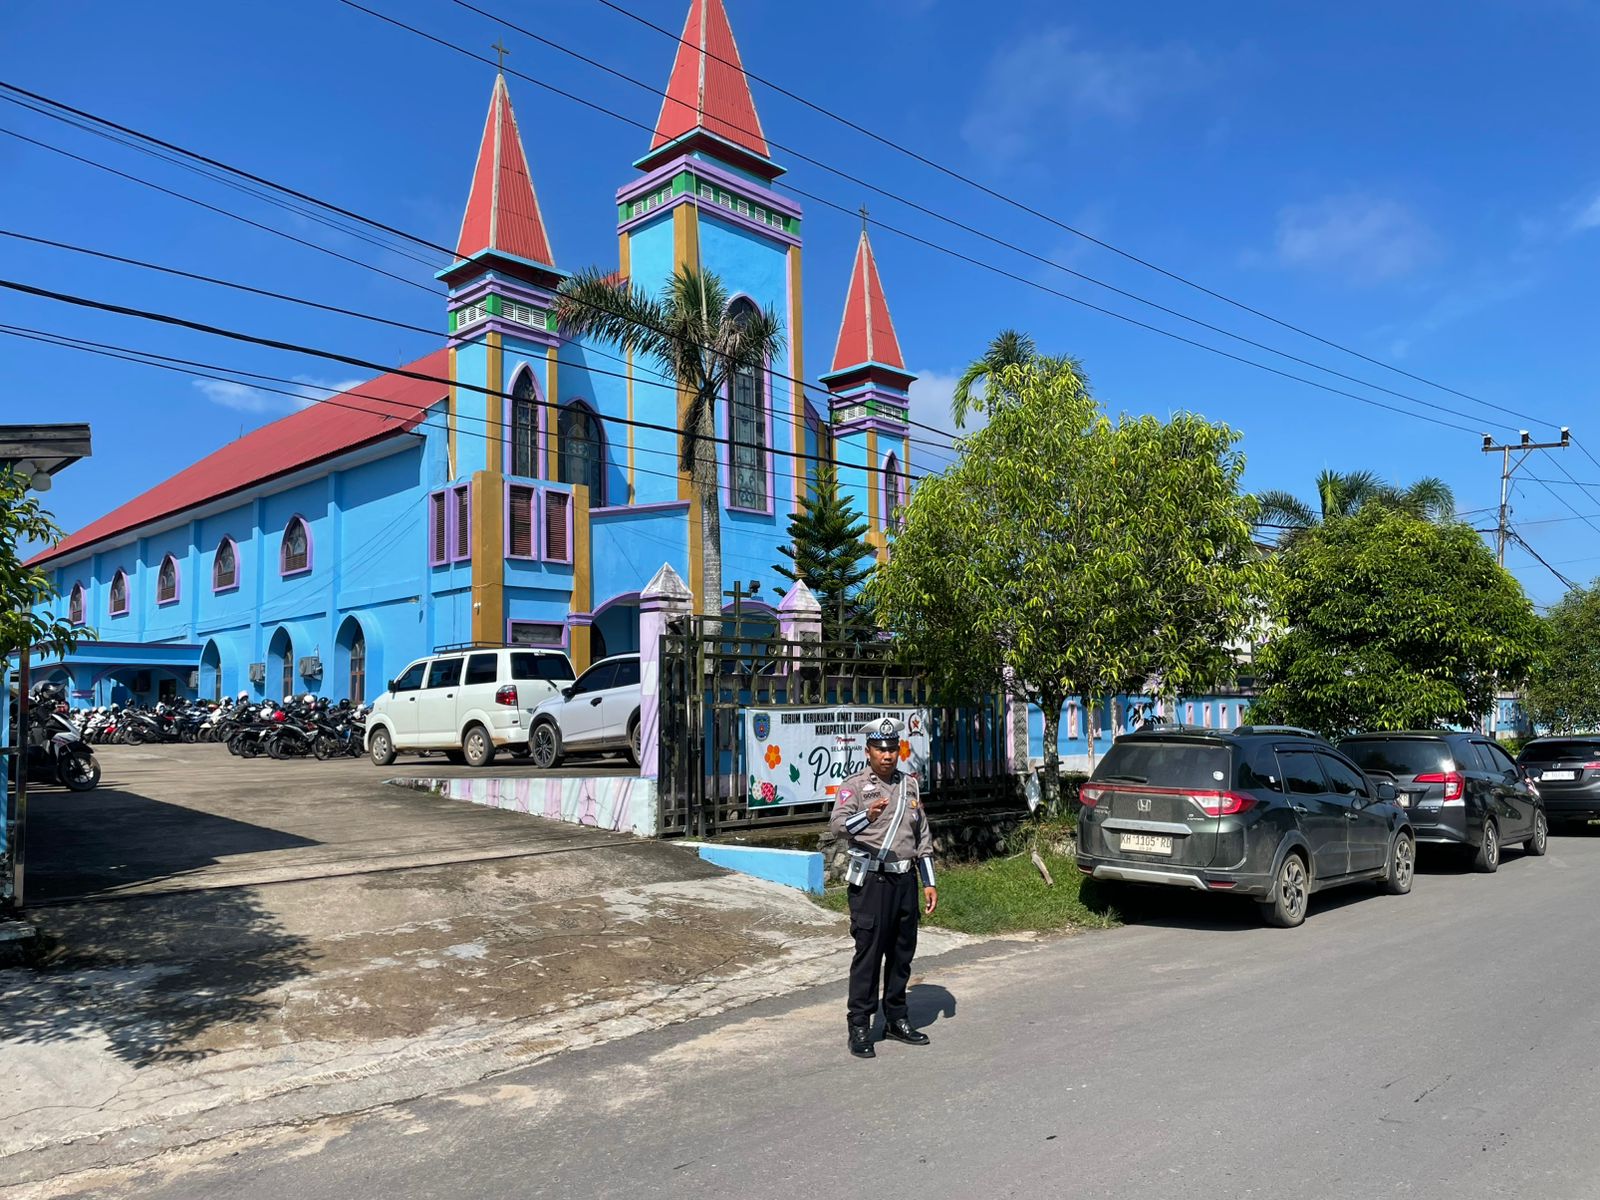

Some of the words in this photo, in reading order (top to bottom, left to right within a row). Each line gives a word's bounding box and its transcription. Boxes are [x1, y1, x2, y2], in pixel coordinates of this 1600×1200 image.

[781, 713, 801, 724] FORUM
[803, 712, 835, 723] KERUKUNAN
[837, 712, 852, 722] UMAT
[815, 724, 847, 735] KABUPATEN
[1121, 833, 1132, 845] KH
[1135, 835, 1156, 847] 1105
